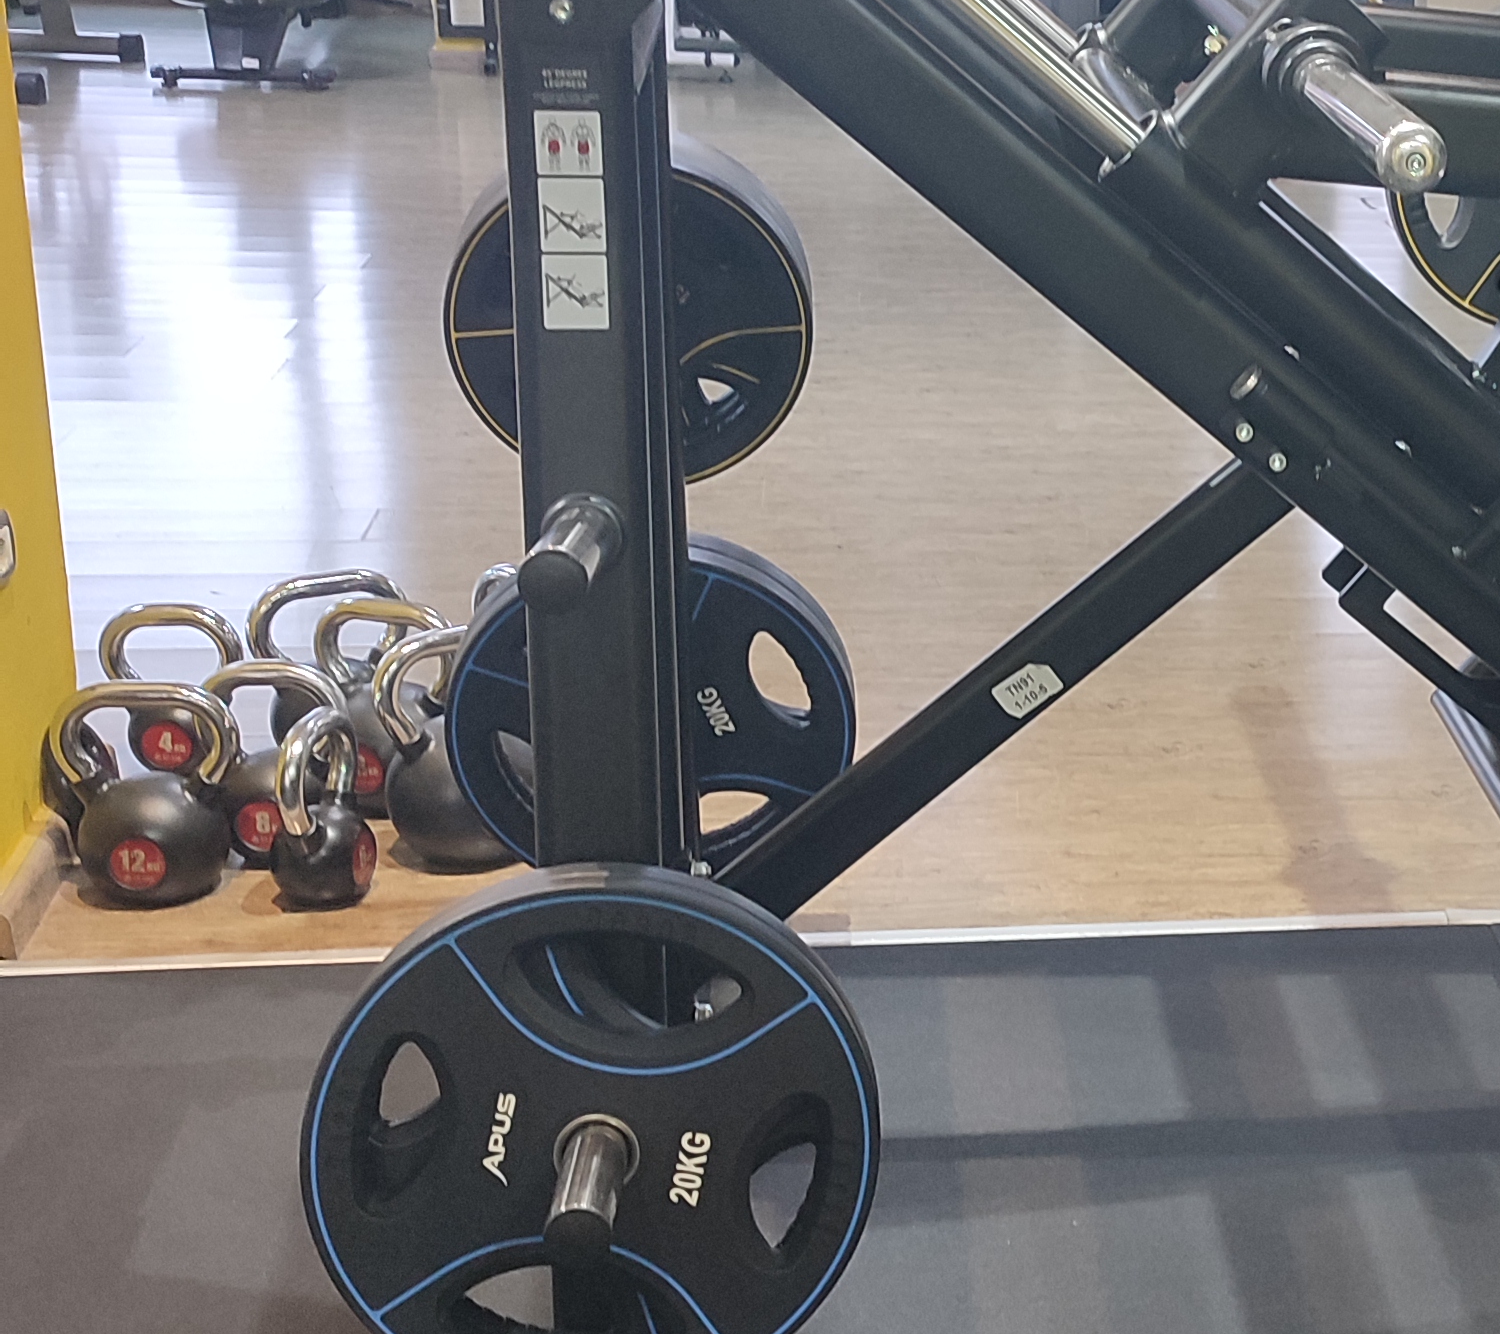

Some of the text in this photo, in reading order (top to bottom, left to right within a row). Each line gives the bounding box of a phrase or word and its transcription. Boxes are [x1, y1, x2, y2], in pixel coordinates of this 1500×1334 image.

[696, 687, 736, 737] 20KG
[482, 1092, 517, 1187] APUS
[669, 1130, 712, 1208] 20KG
